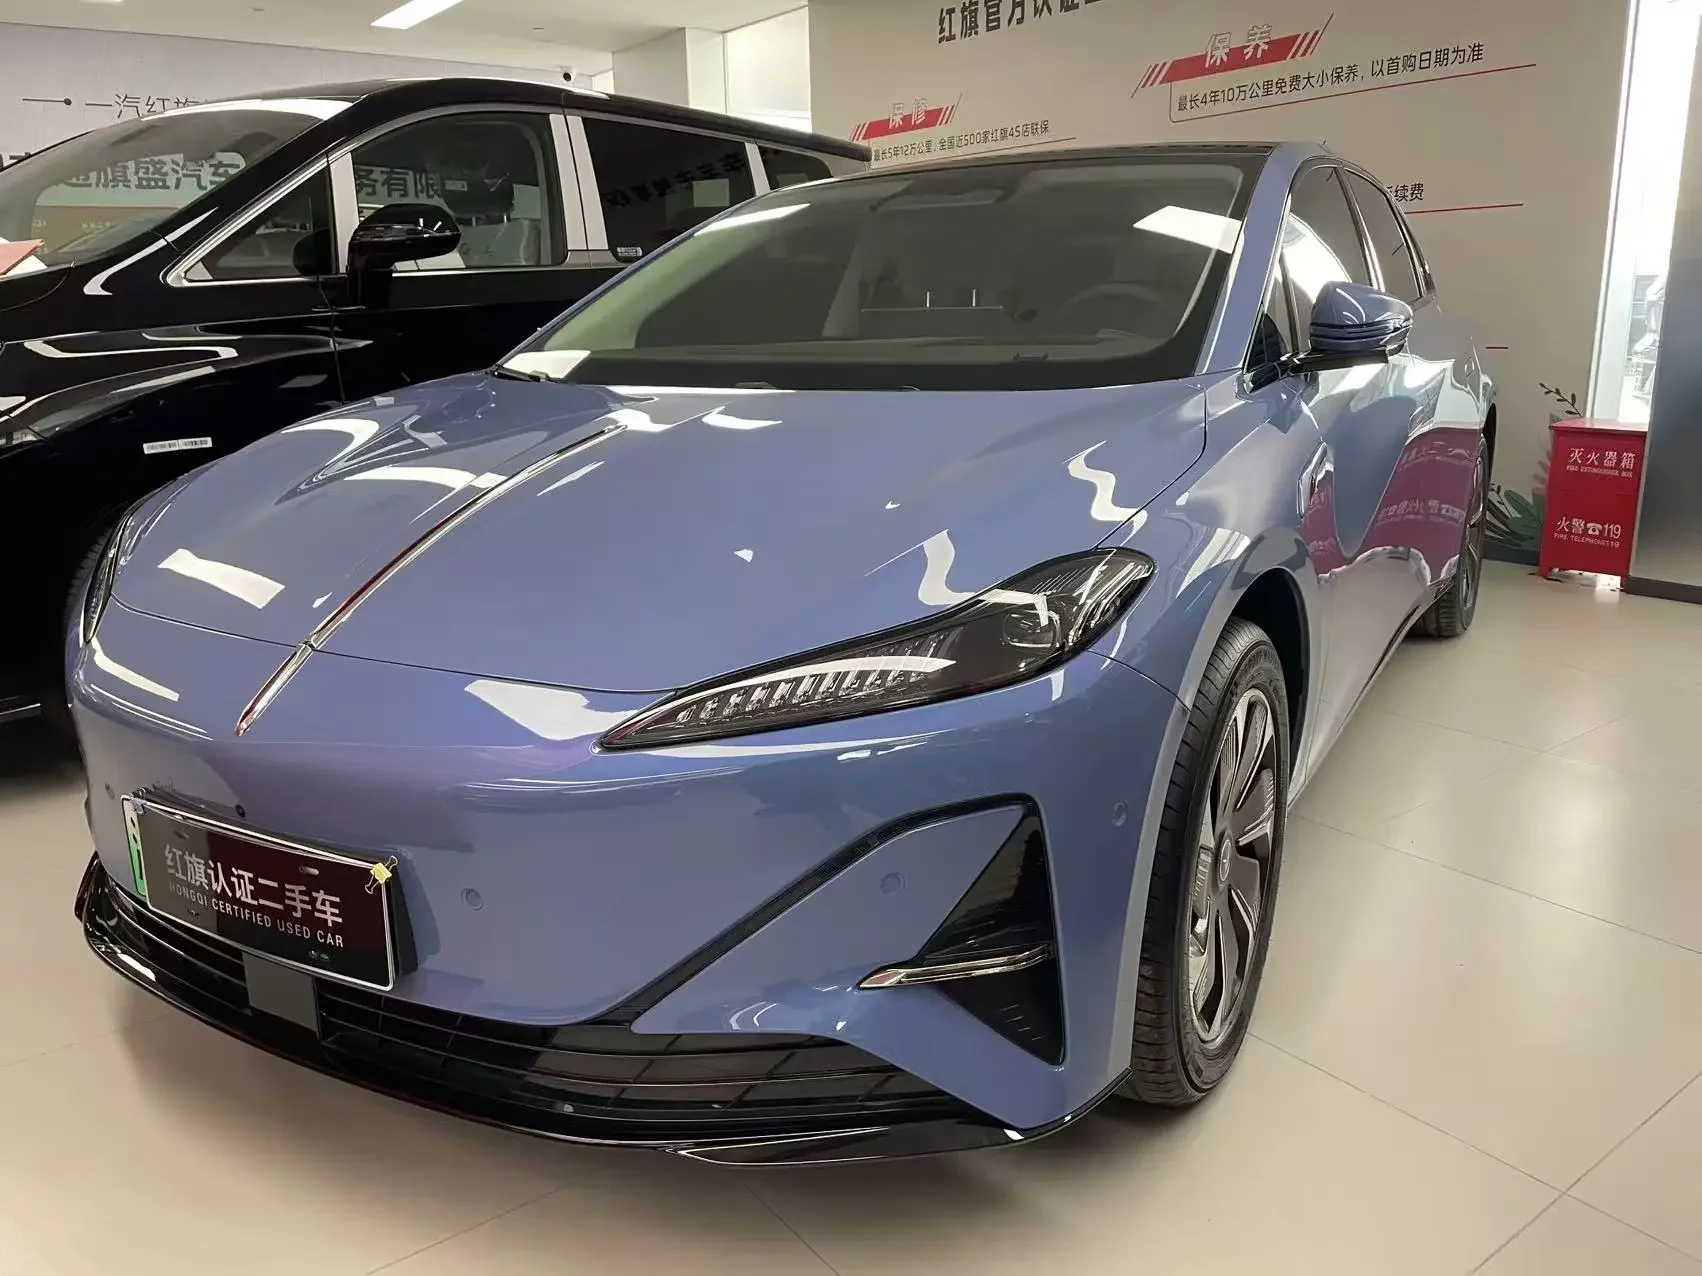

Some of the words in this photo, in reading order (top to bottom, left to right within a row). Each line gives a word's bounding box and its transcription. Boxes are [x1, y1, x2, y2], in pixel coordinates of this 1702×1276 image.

[938, 0, 1100, 44] 红旗官方
[1205, 23, 1273, 68] 保养
[888, 96, 928, 130] 保修
[1569, 448, 1635, 469] 灭火器箱
[1621, 470, 1633, 478] BOX
[1553, 532, 1567, 540] FIRE
[1557, 516, 1585, 534] 火警
[1603, 523, 1621, 539] 119
[165, 843, 343, 928] 红旗认证二手车
[168, 882, 208, 907] HONGQI
[211, 897, 272, 928] CERTIFIED
[277, 919, 311, 939] USED
[316, 930, 344, 948] CAR
